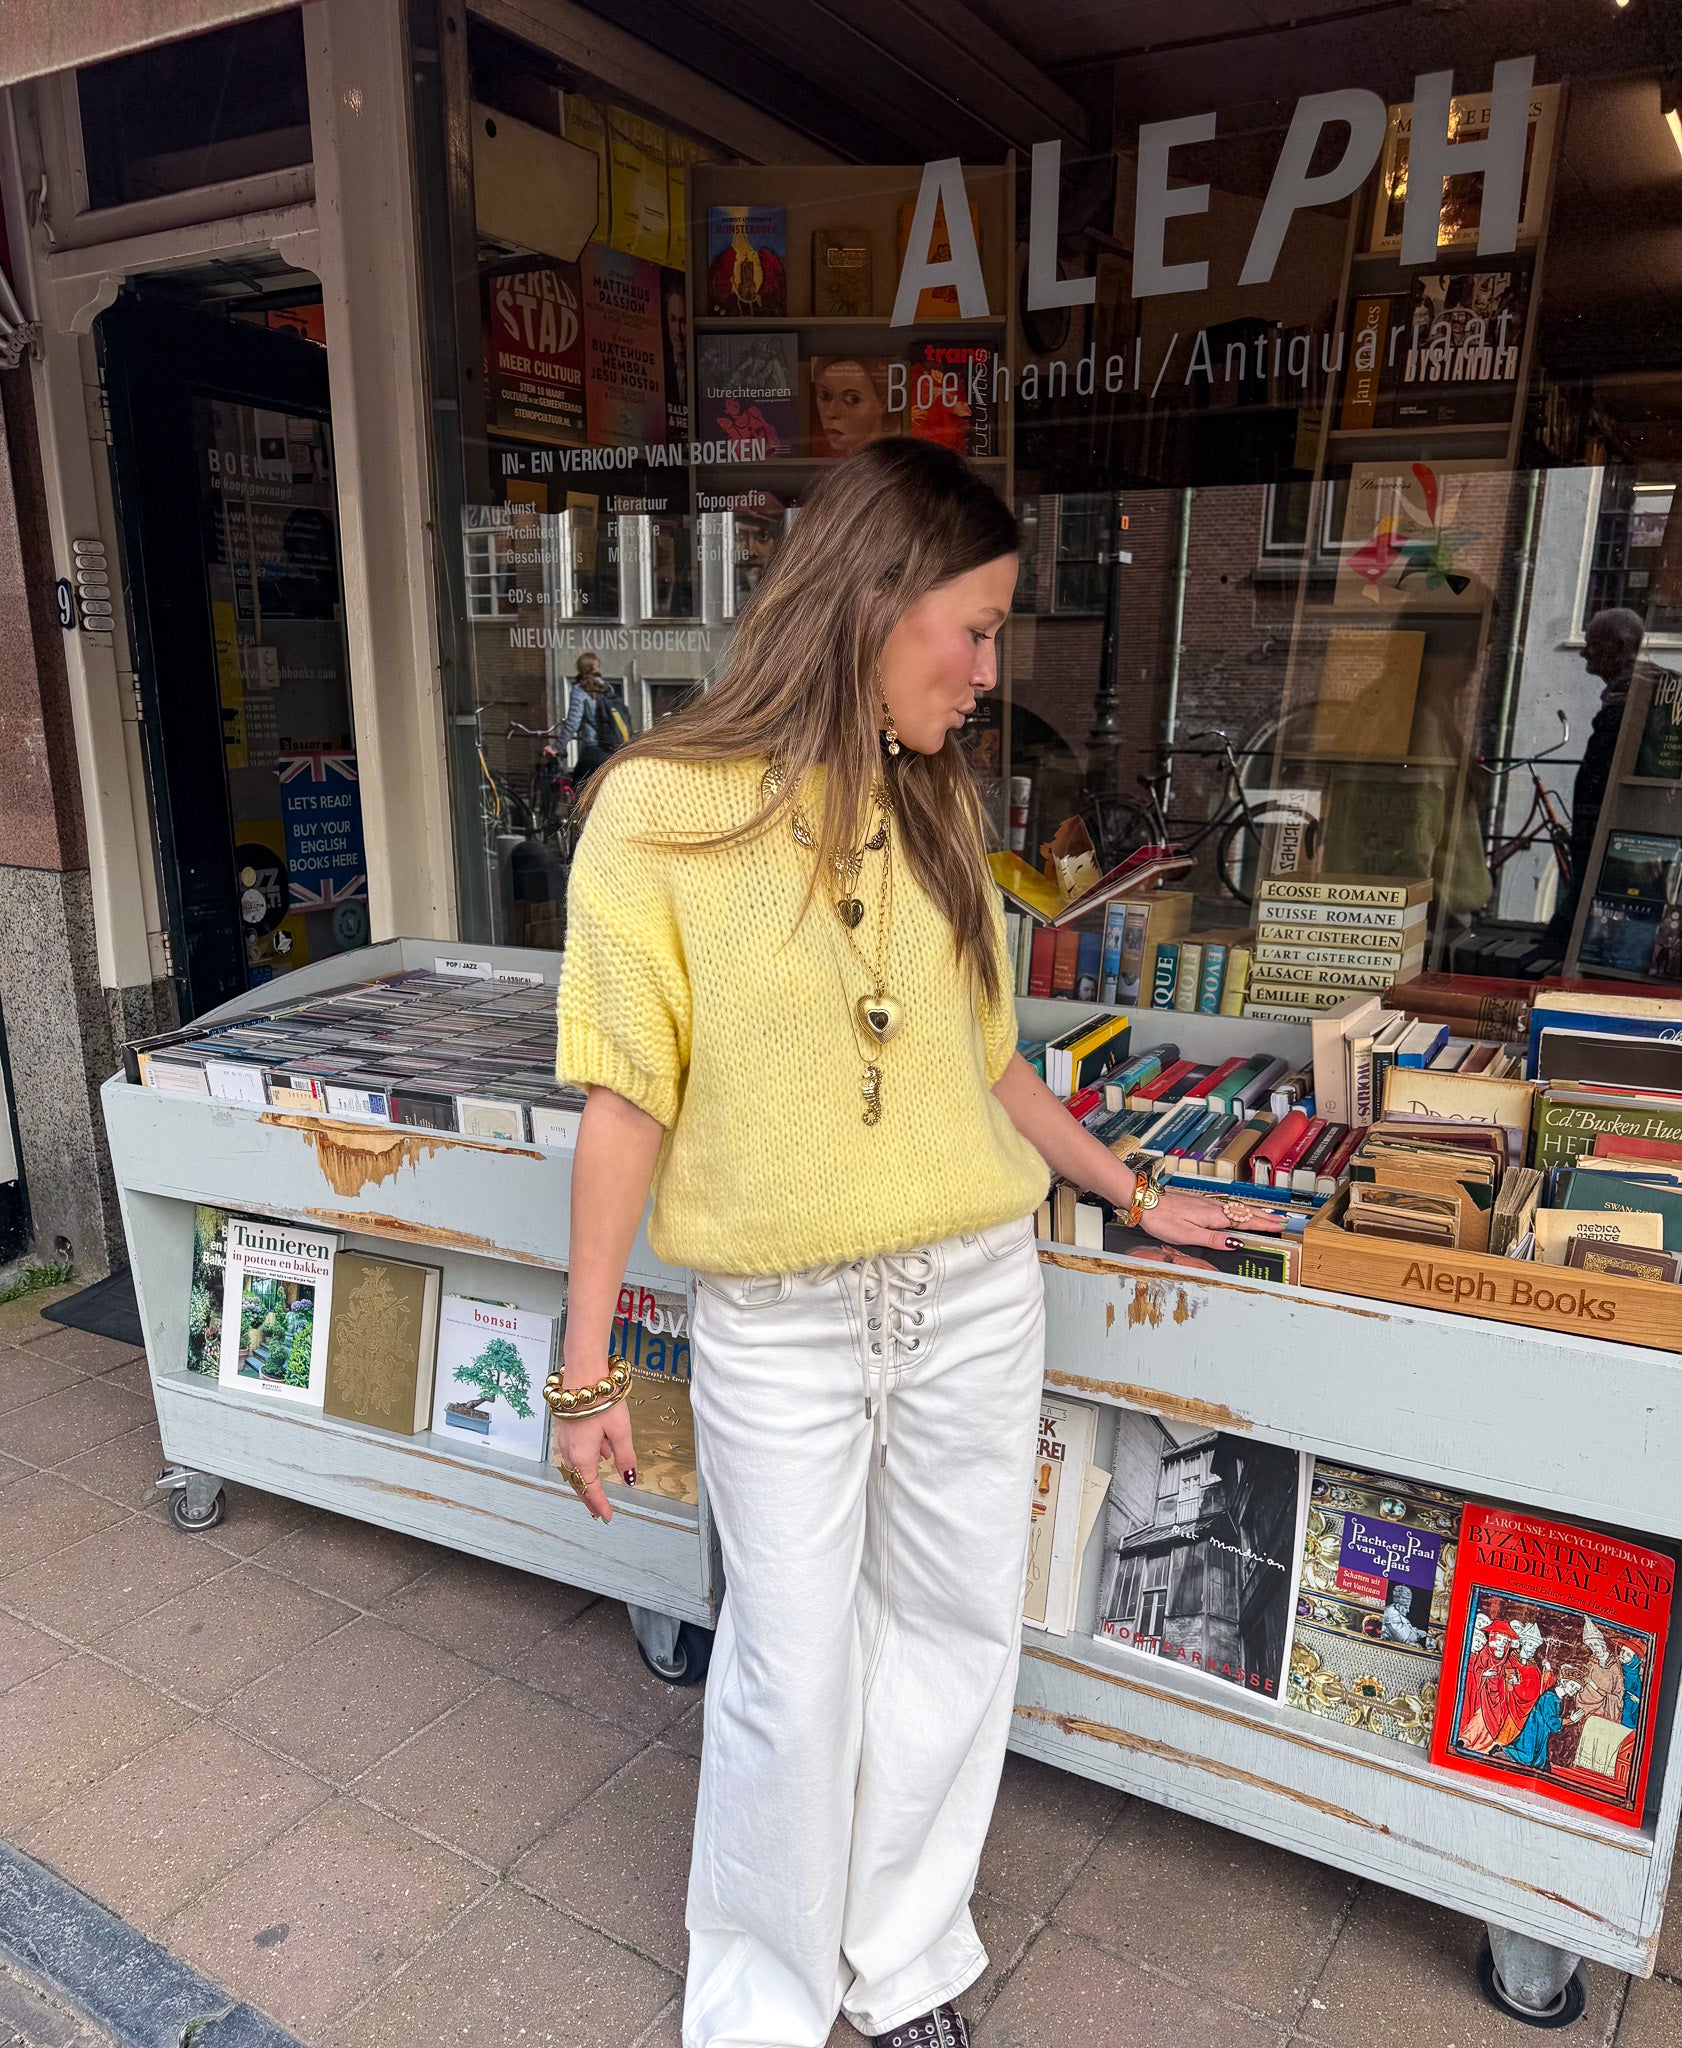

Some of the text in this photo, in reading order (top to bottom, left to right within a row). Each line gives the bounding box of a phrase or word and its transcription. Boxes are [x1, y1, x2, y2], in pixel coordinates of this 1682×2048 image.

[889, 55, 1535, 327] ALEPH
[495, 289, 578, 354] STAD
[592, 339, 656, 365] BUXTEHUDE
[499, 351, 581, 386] MEER CULTUUR
[591, 368, 617, 383] JESU
[602, 356, 647, 376] MEMBRA
[1404, 346, 1519, 383] BYSTANDER
[501, 389, 528, 403] CULTUUR
[520, 382, 537, 393] STEM
[547, 388, 565, 400] MAART
[707, 386, 790, 399] Utrechtenaren
[1352, 378, 1371, 406] Jan
[502, 438, 766, 475] IN- EN VERKOOP VAN BOEKEN
[210, 476, 220, 488] te
[504, 500, 536, 516] Kunst
[606, 495, 668, 512] Literatuur
[696, 490, 766, 513] Topografie
[57, 585, 70, 624] 9
[508, 589, 533, 605] CD's
[537, 592, 550, 604] en
[510, 628, 711, 652] NIEUWE KUNSTBOEKEN
[288, 794, 352, 811] LET'S READ!
[293, 820, 351, 838] BUY YOUR
[301, 838, 347, 854] ENGLISH
[289, 853, 359, 873] BOOKS HERE
[1267, 883, 1400, 903] ÉCOSSE ROMANE
[1266, 907, 1397, 925] SUISSE ROMANE
[1261, 927, 1400, 948] L'ART CISTERCIEN
[1262, 948, 1300, 960] L'ART
[1154, 957, 1174, 1010] QUE
[1256, 966, 1391, 986] ALSACE ROMANE
[1256, 987, 1309, 1002] ÉMILIE
[1357, 1062, 1370, 1116] WORDS
[1545, 1108, 1682, 1142] Cd. Busken Hue
[1543, 1133, 1594, 1156] HET
[210, 1241, 222, 1252] en
[233, 1225, 330, 1261] Tuinieren
[233, 1250, 329, 1276] in potten en bakken
[1400, 1262, 1617, 1322] Aleph Books
[616, 1286, 656, 1325] gh
[474, 1308, 517, 1330] bonsai
[631, 1366, 663, 1380] Photography
[1037, 1438, 1066, 1462] REI
[1348, 1517, 1435, 1564] Pracht en Praal
[1355, 1544, 1376, 1556] van
[1484, 1515, 1658, 1570] LAROUSSE ENCYCLOPEDIA OF
[1373, 1545, 1411, 1578] de Paus
[1468, 1525, 1672, 1596] BYZANTINE AND
[1342, 1578, 1381, 1597] het Vaticaan
[1343, 1569, 1381, 1587] Schatten uit
[1475, 1546, 1659, 1612] MEDIEVAL ART
[1507, 1578, 1539, 1593] General
[1102, 1620, 1275, 1693] MONTPARNASSE
